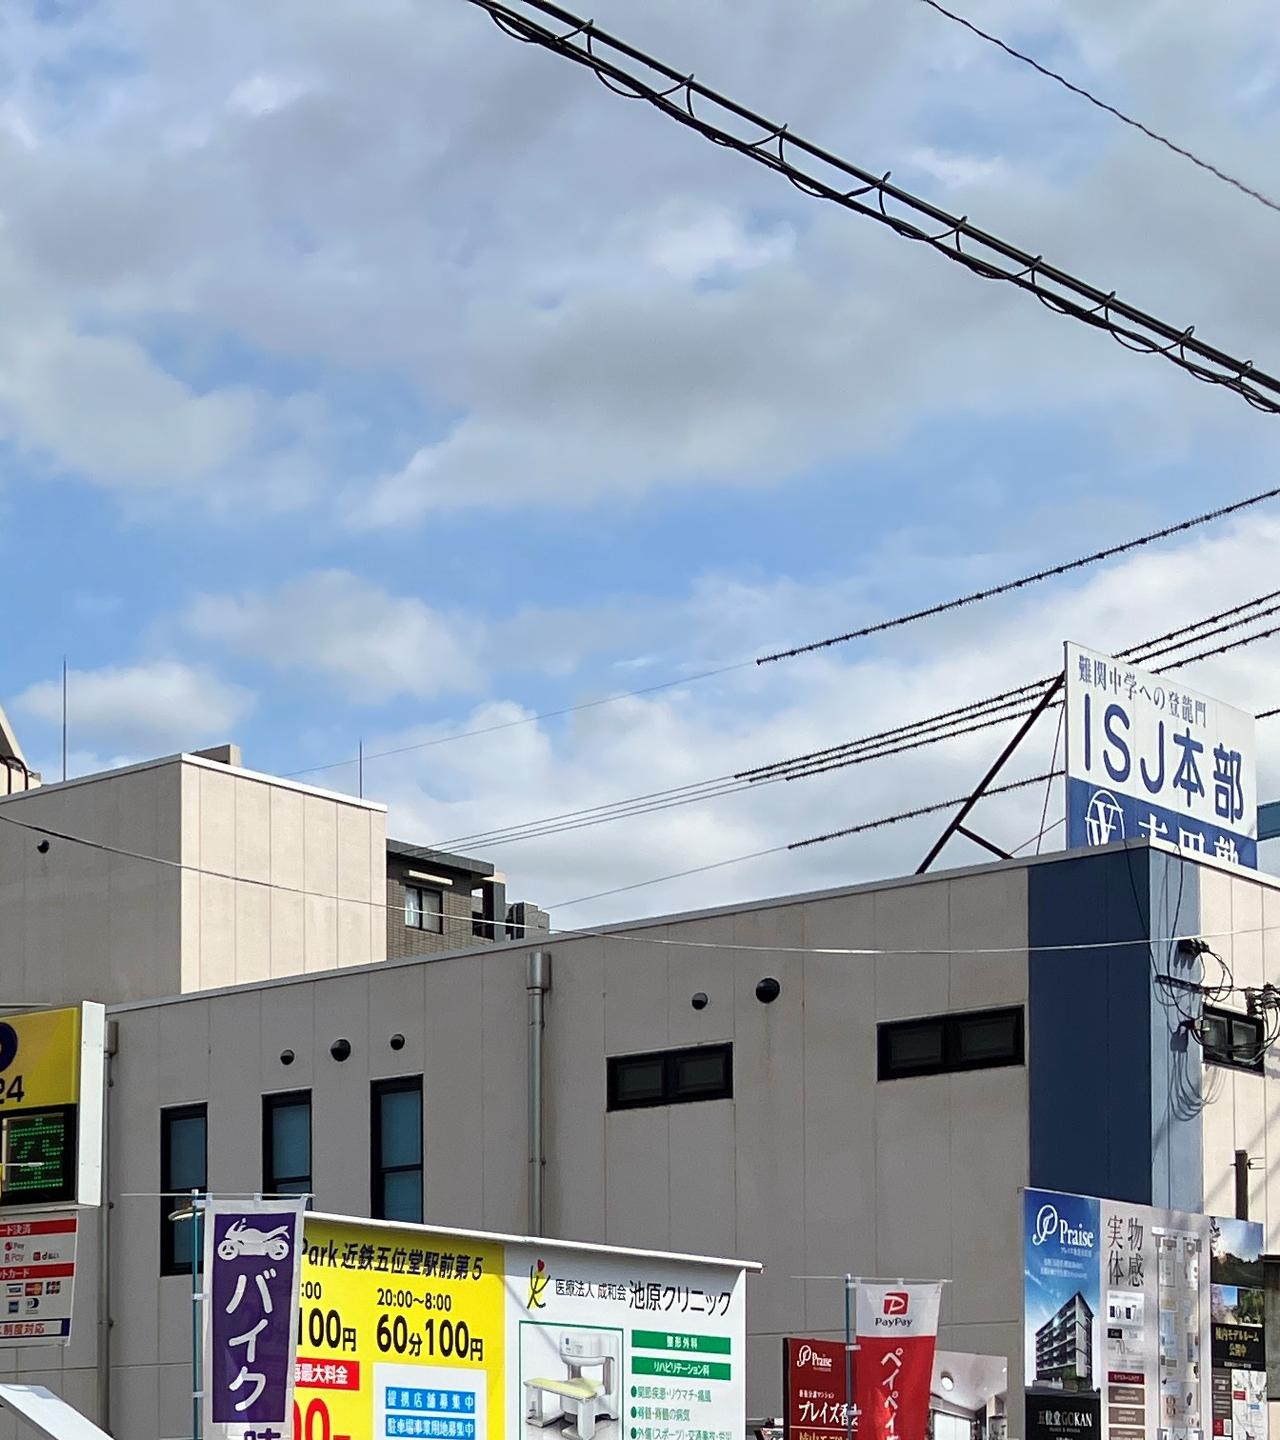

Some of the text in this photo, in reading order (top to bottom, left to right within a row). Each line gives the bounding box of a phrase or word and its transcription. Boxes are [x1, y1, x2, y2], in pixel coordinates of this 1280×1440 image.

[1083, 693, 1245, 825] ISJ本部
[1059, 1219, 1095, 1248] Praise
[340, 1242, 484, 1281] 近鉄五位堂駅前第5
[555, 1278, 733, 1317] 医療法人 成和会 池原クリニック
[376, 1313, 484, 1362] 60分100円
[874, 1317, 913, 1328] PayPay
[225, 1267, 277, 1413] バイク
[666, 1335, 698, 1350] 整形外科
[653, 1360, 710, 1377] リハビリテーション科
[387, 1389, 474, 1411] 提携店舗募集中
